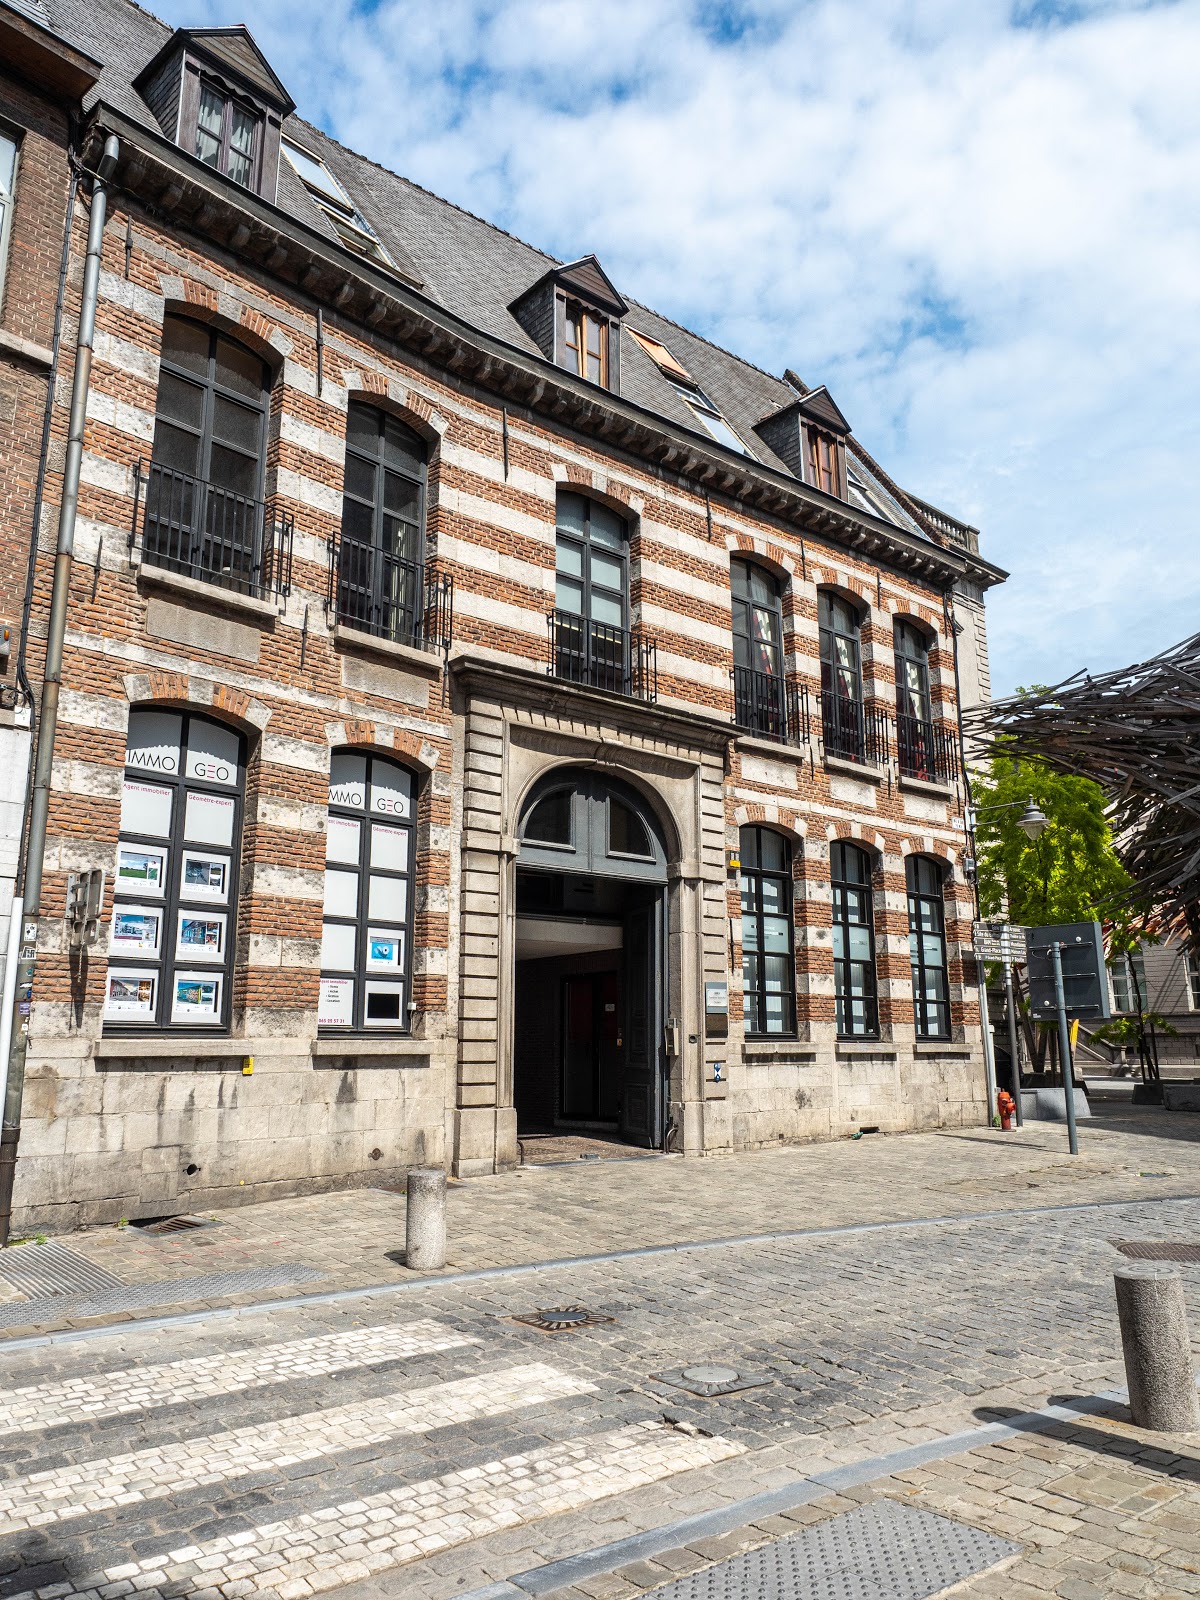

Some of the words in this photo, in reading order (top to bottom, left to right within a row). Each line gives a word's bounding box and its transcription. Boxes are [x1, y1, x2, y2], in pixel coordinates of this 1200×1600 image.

[128, 749, 176, 771] IMMO
[194, 762, 229, 781] GEO
[123, 783, 140, 792] Agent
[141, 786, 171, 796] immobilier
[328, 789, 362, 806] MMO
[377, 798, 404, 814] GEO
